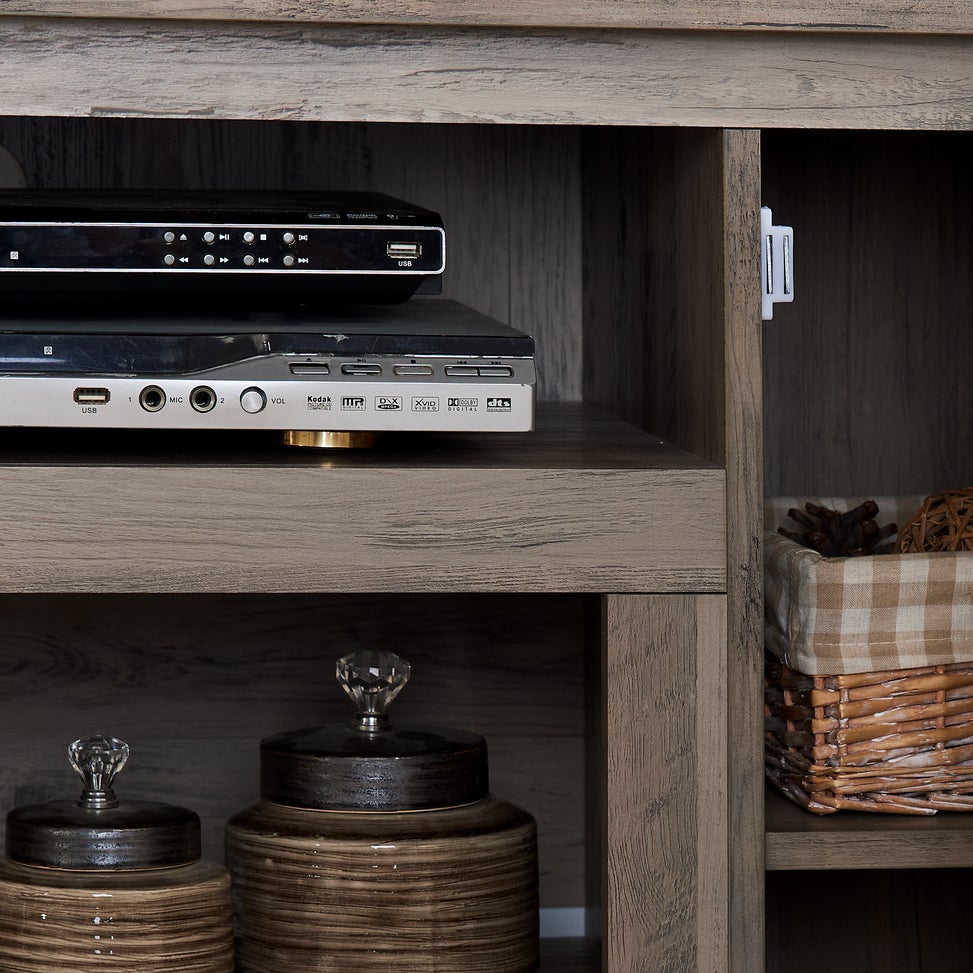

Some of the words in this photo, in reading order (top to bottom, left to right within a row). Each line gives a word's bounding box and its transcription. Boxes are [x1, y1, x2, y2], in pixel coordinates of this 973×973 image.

[169, 396, 184, 404] MIC
[271, 397, 286, 405] VOL
[307, 395, 332, 403] Kodak
[487, 398, 511, 407] dts
[81, 406, 98, 414] USB
